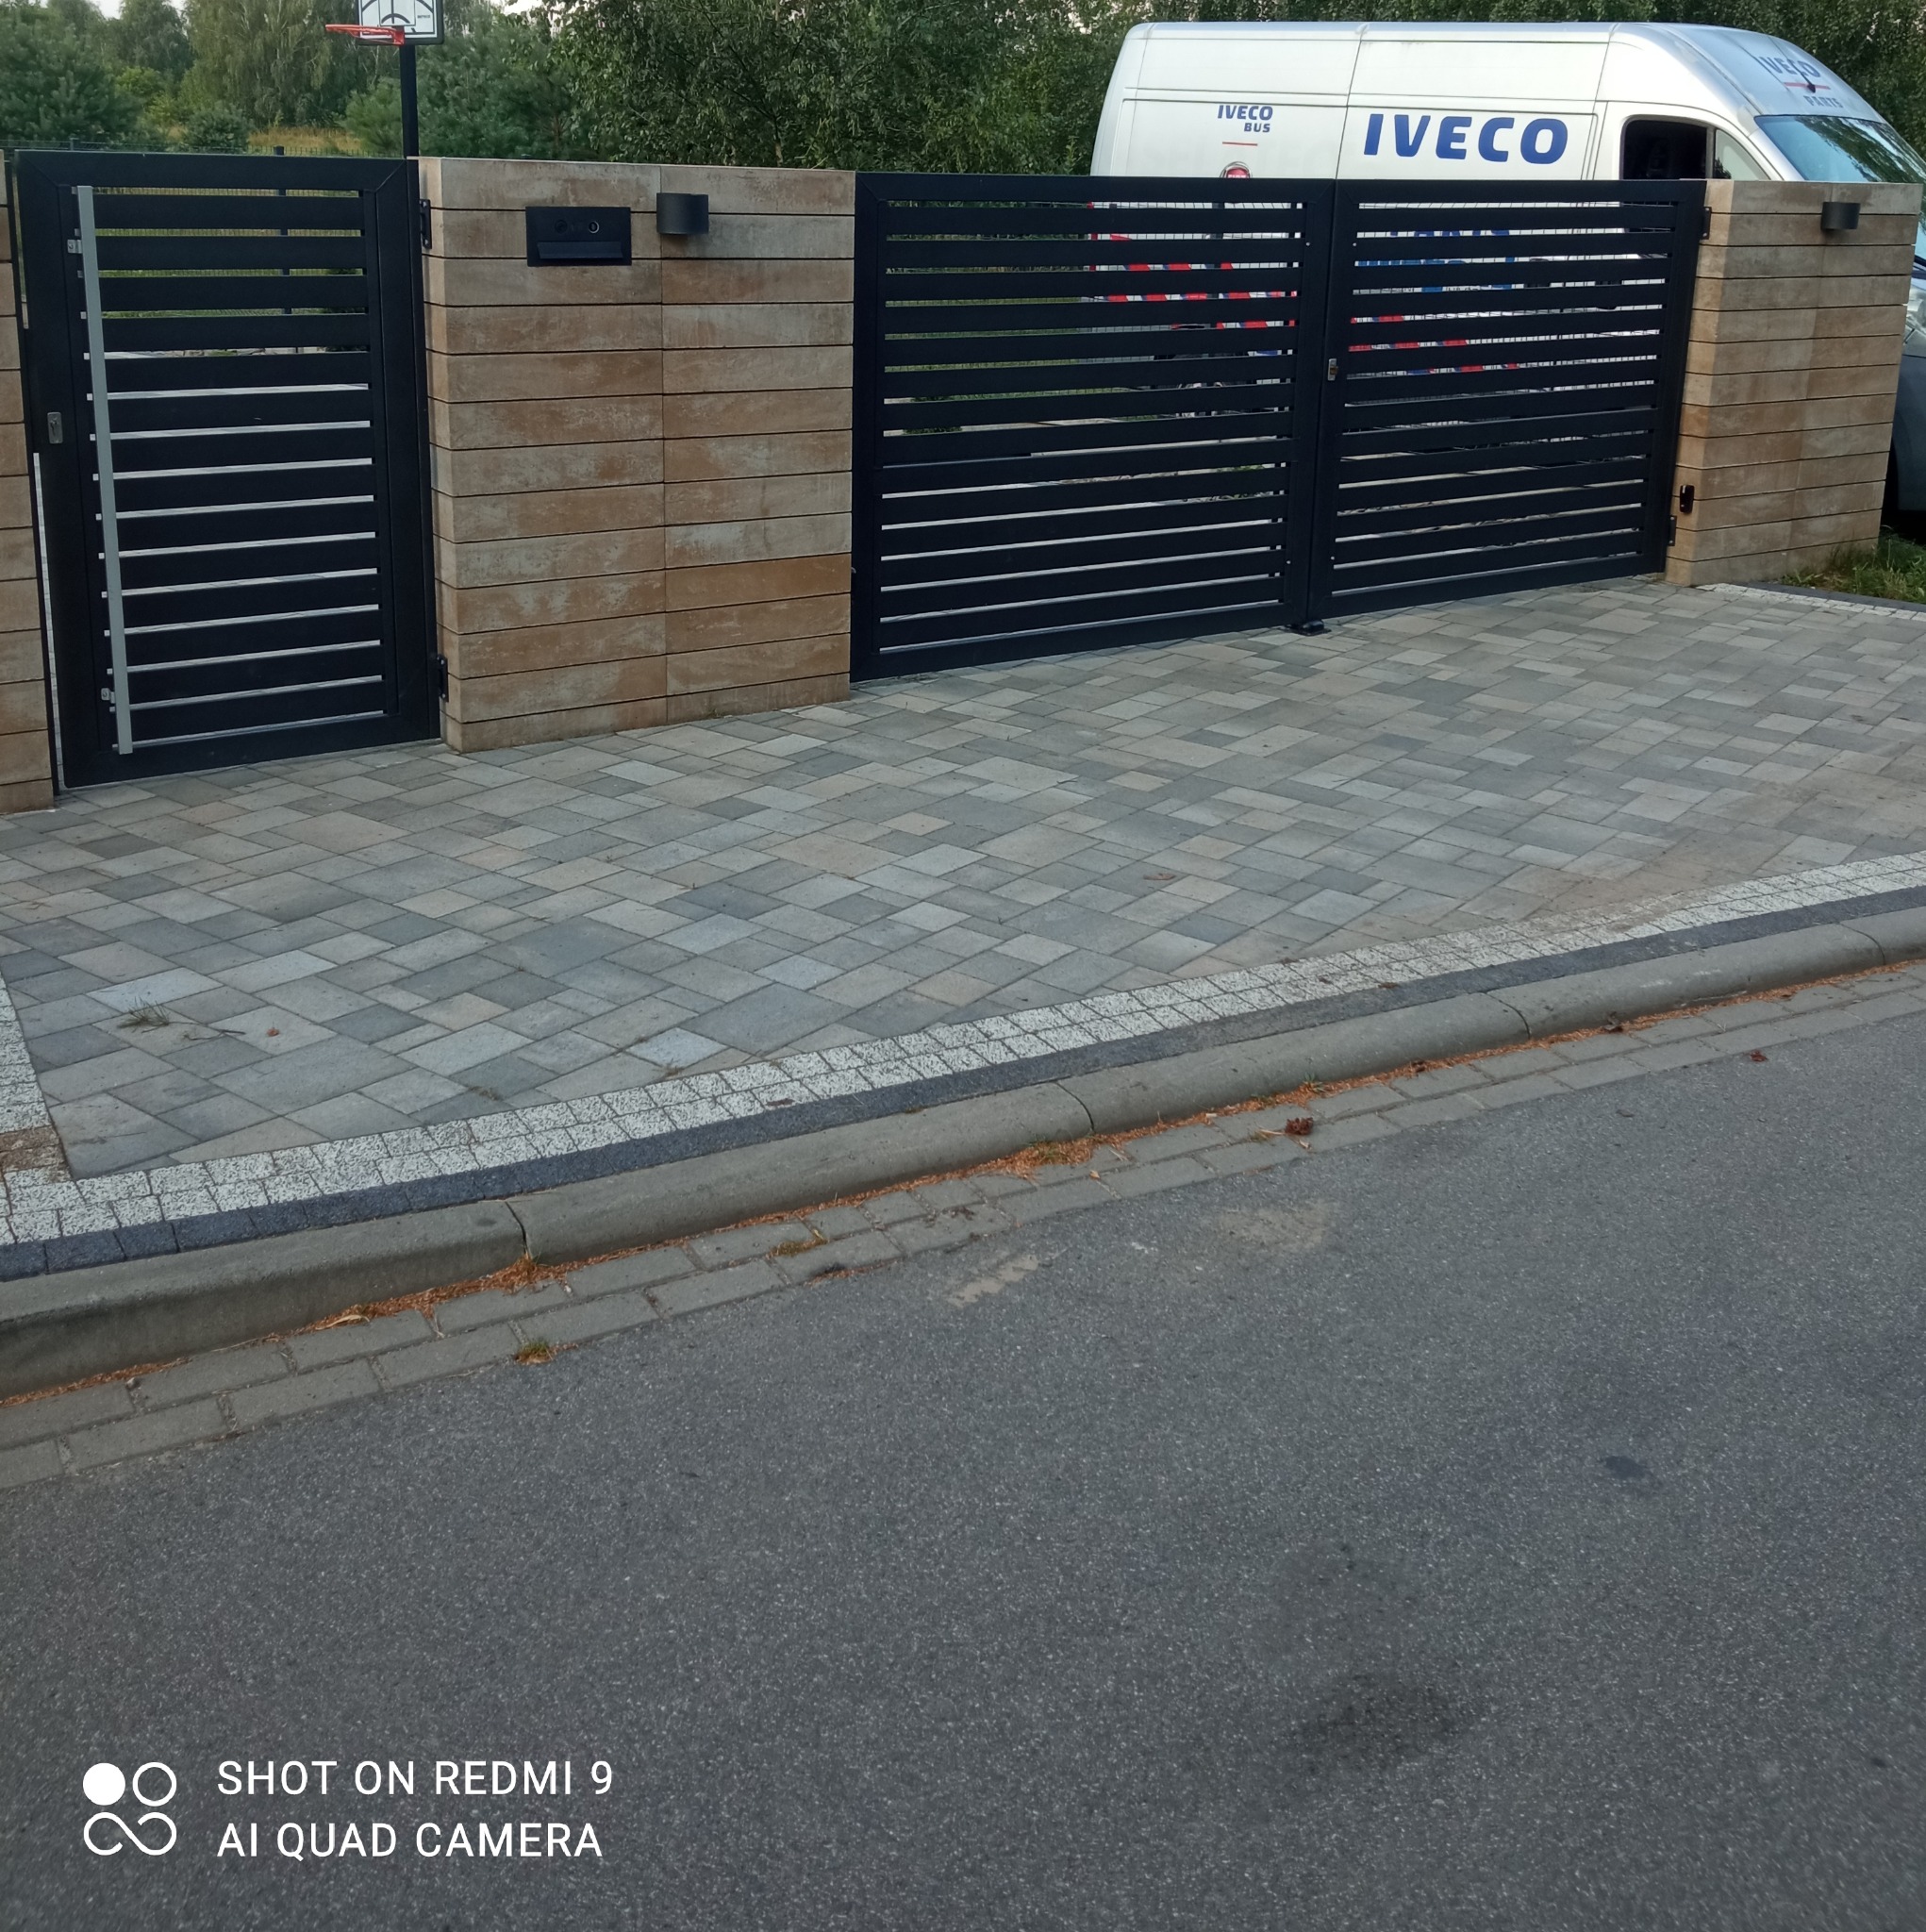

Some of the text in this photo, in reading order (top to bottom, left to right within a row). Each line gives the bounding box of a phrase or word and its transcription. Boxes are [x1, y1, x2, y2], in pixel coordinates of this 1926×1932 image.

[1758, 56, 1821, 78] IVECO
[1802, 95, 1844, 108] PARTS
[1217, 105, 1273, 121] IVECO
[1243, 122, 1270, 133] BUS
[1363, 113, 1569, 165] IVECO
